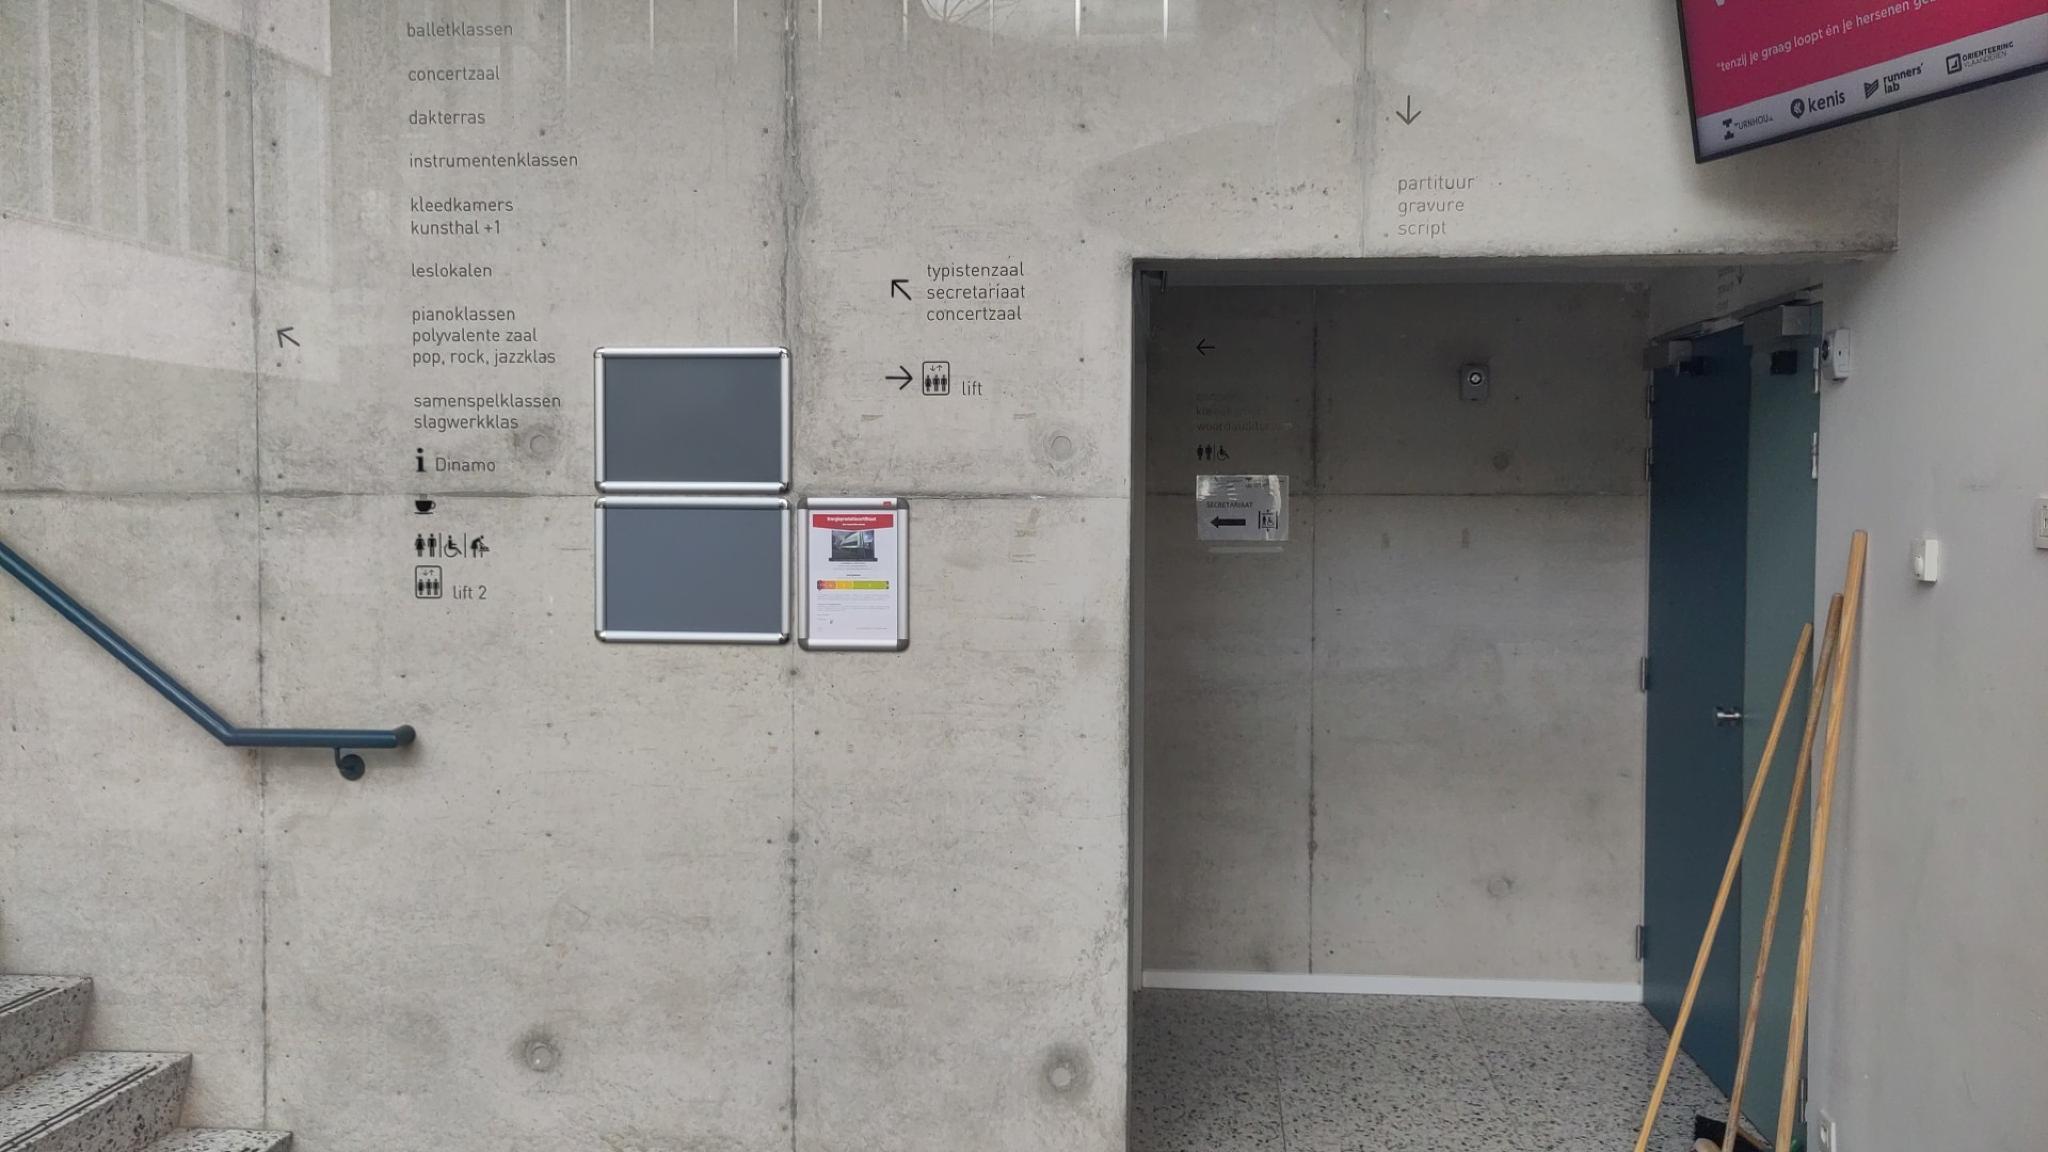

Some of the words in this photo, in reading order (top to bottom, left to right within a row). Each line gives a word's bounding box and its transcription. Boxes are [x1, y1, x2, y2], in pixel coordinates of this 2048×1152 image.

[406, 21, 513, 37] balletklassen
[1749, 50, 1759, 65] je
[1761, 41, 1792, 61] graag
[1793, 28, 1823, 48] loopt
[1842, 18, 1854, 34] je
[1855, 0, 1910, 28] hersenen
[1962, 40, 2014, 62] ORIENTEERING
[408, 65, 500, 81] concertzaal
[1884, 81, 1901, 95] lab
[1807, 89, 1846, 113] kenis
[409, 109, 486, 125] dakterras
[409, 152, 578, 168] instrumentenklassen
[1397, 175, 1475, 194] partituur
[410, 196, 514, 212] kleedkamers
[1397, 200, 1465, 217] gravure
[411, 219, 480, 235] kunsthal
[483, 219, 500, 235] +1
[1397, 220, 1447, 239] script
[411, 262, 493, 278] leslokalen
[926, 261, 1025, 282] typistenzaal
[926, 284, 1026, 300] secretariaat
[412, 306, 516, 325] pianoklassen
[926, 305, 1023, 321] concertzaal
[412, 328, 501, 346] polyvalente
[505, 327, 538, 343] zaal
[412, 350, 446, 368] pop,
[450, 348, 490, 366] rock,
[493, 348, 557, 368] jazzklas
[961, 380, 983, 396] lift
[413, 393, 562, 412] samenspelklassen
[413, 414, 519, 433] slagwerkklas
[435, 456, 496, 472] Dinamo
[1206, 501, 1253, 509] SECRETARIAAT
[452, 585, 473, 600] lift
[478, 584, 488, 600] 2
